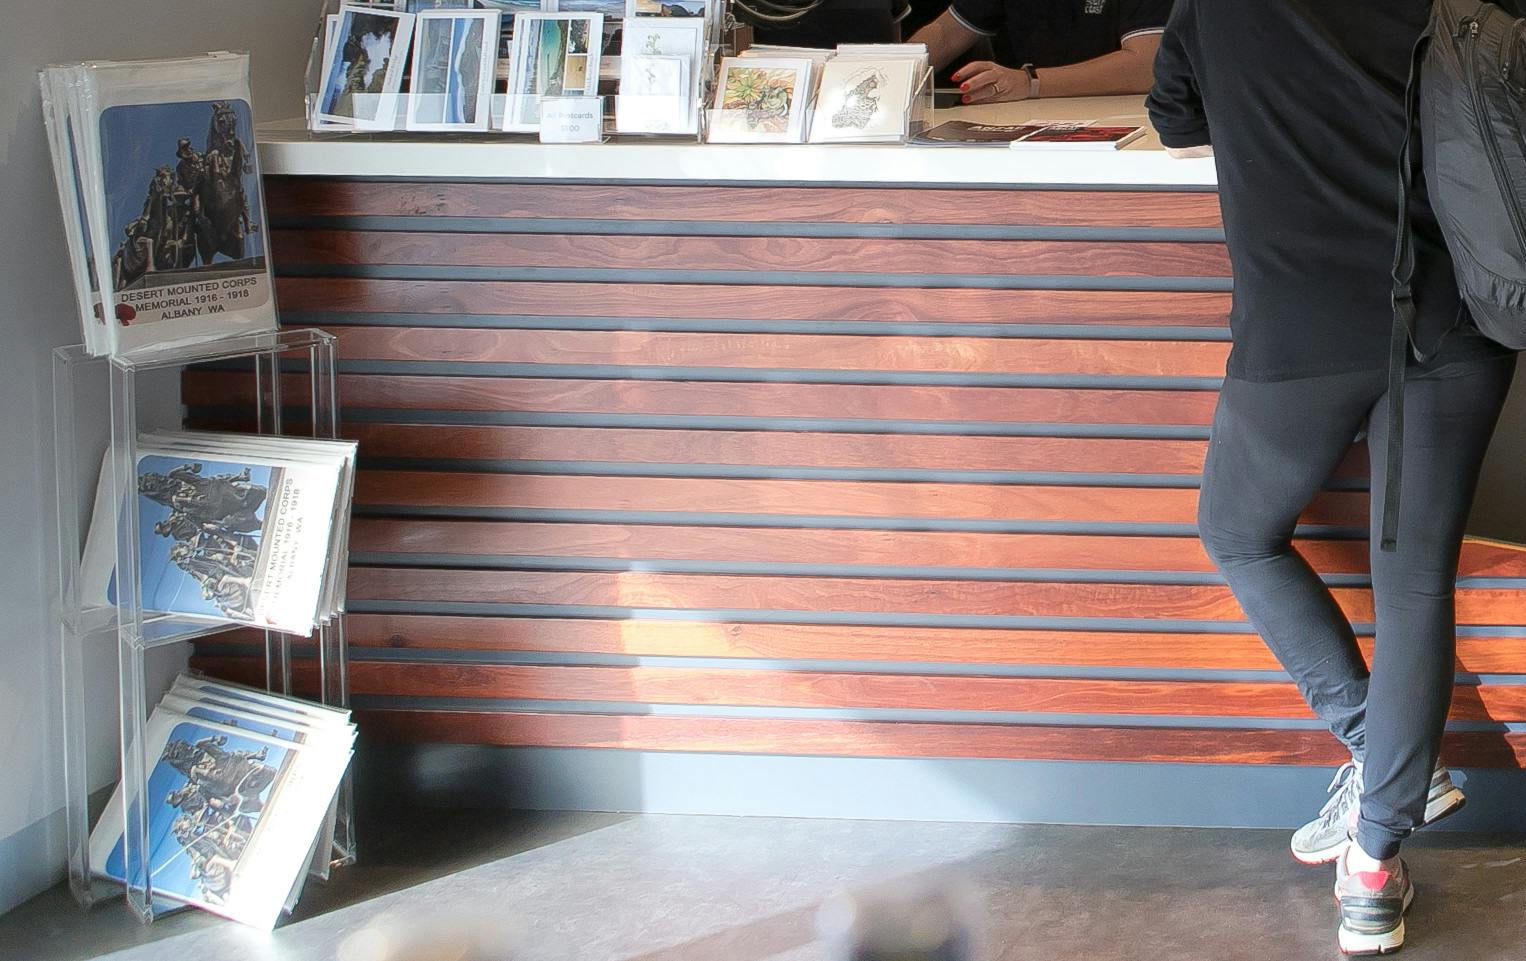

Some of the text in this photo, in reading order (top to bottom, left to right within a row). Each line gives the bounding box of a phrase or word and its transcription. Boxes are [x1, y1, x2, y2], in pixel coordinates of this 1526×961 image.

[121, 277, 257, 303] DESERT MOUNTED CORPS
[135, 298, 192, 312] MEMORIAL
[227, 289, 250, 300] 1918
[161, 304, 225, 321] ALBANY WA
[279, 477, 294, 516] CORPS
